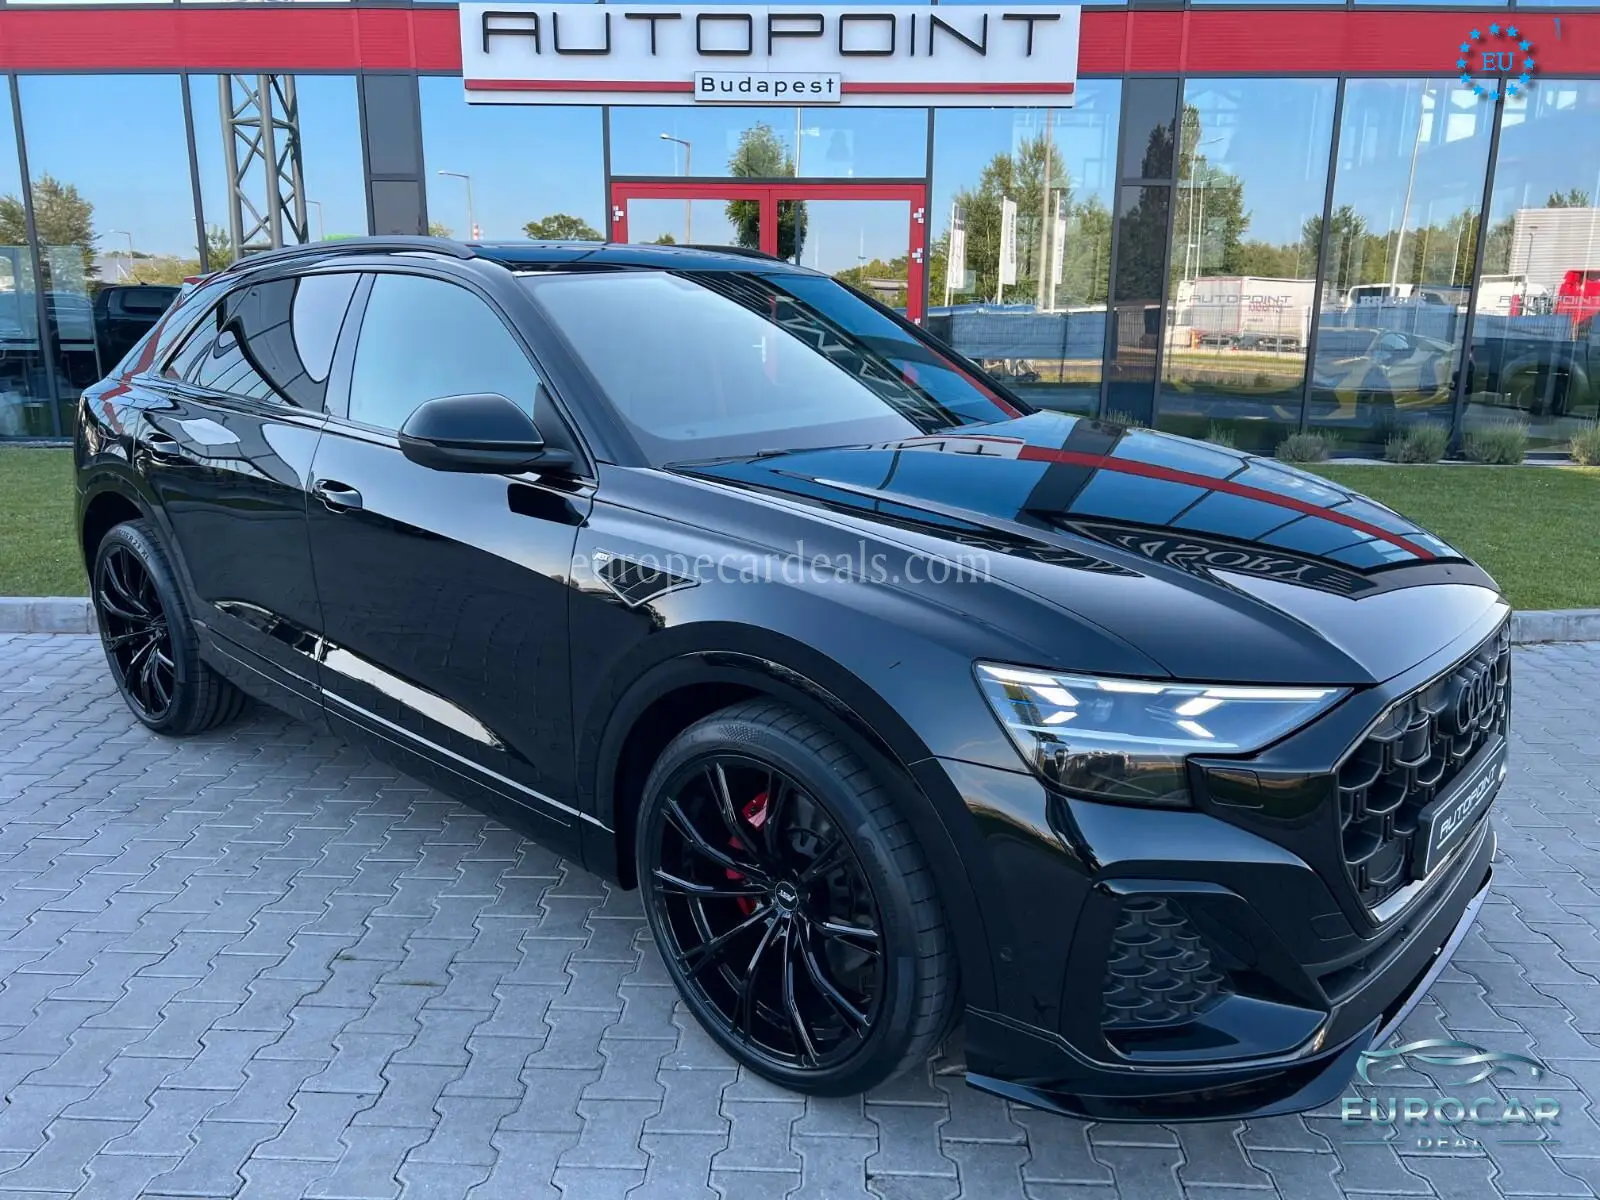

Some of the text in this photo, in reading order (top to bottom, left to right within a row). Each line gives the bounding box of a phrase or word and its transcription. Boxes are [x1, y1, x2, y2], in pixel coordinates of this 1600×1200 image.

[482, 11, 1060, 57] AUTOPOINT
[701, 77, 834, 96] Budapest
[1190, 294, 1293, 304] AUTOPOINT
